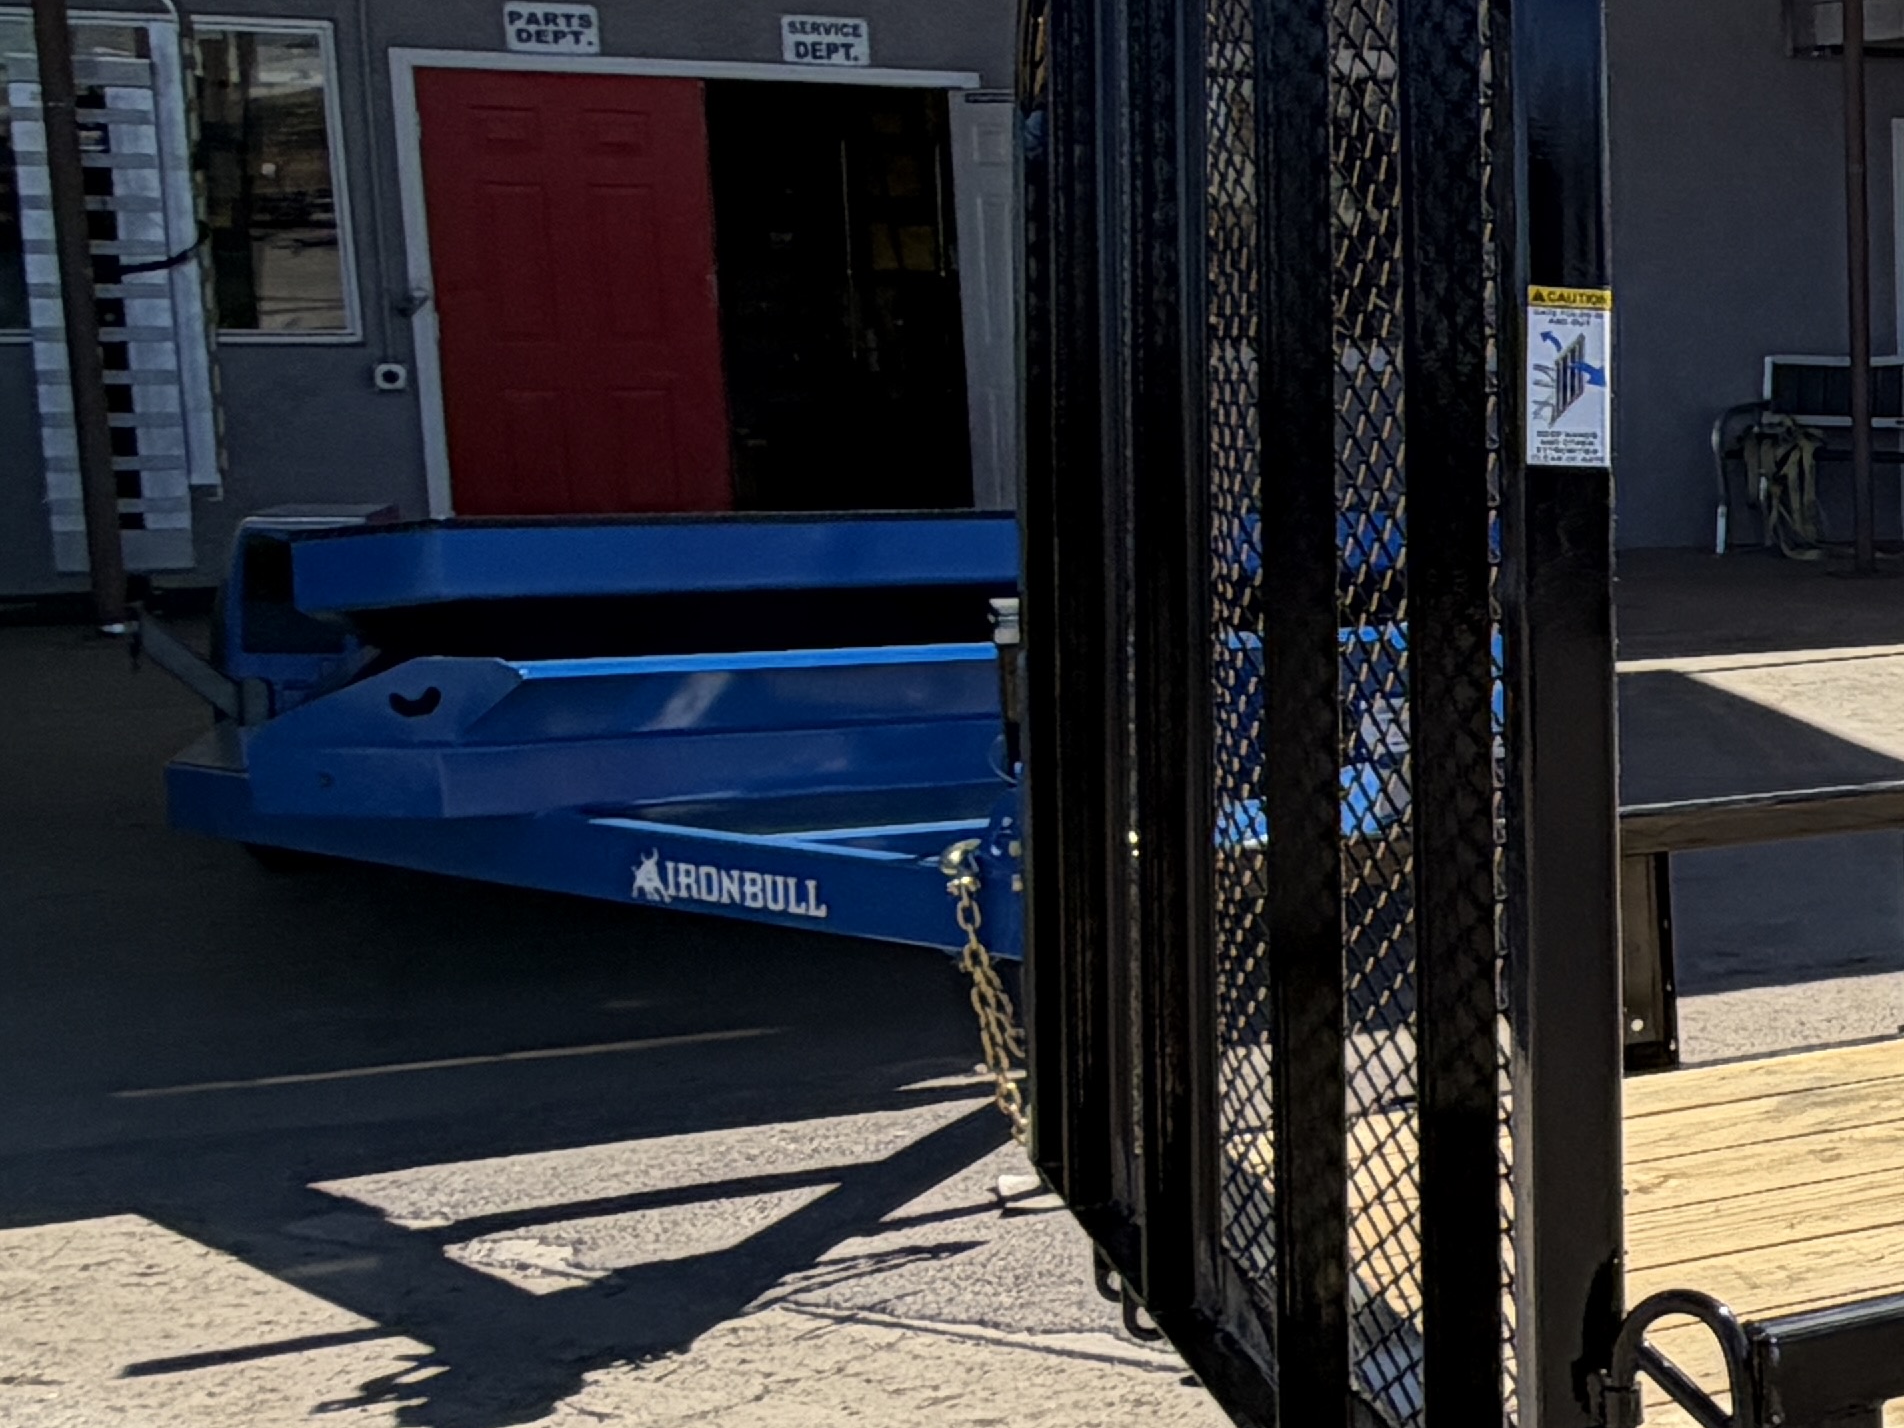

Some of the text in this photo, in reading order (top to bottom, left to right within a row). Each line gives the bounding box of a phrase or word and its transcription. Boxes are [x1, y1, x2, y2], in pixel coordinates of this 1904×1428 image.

[507, 10, 592, 29] PARTS
[515, 28, 594, 46] DEPT.
[787, 20, 862, 38] SERVICE
[794, 40, 860, 62] DEPT.
[1546, 290, 1606, 305] CAUTION
[664, 860, 828, 918] IRONBULL
